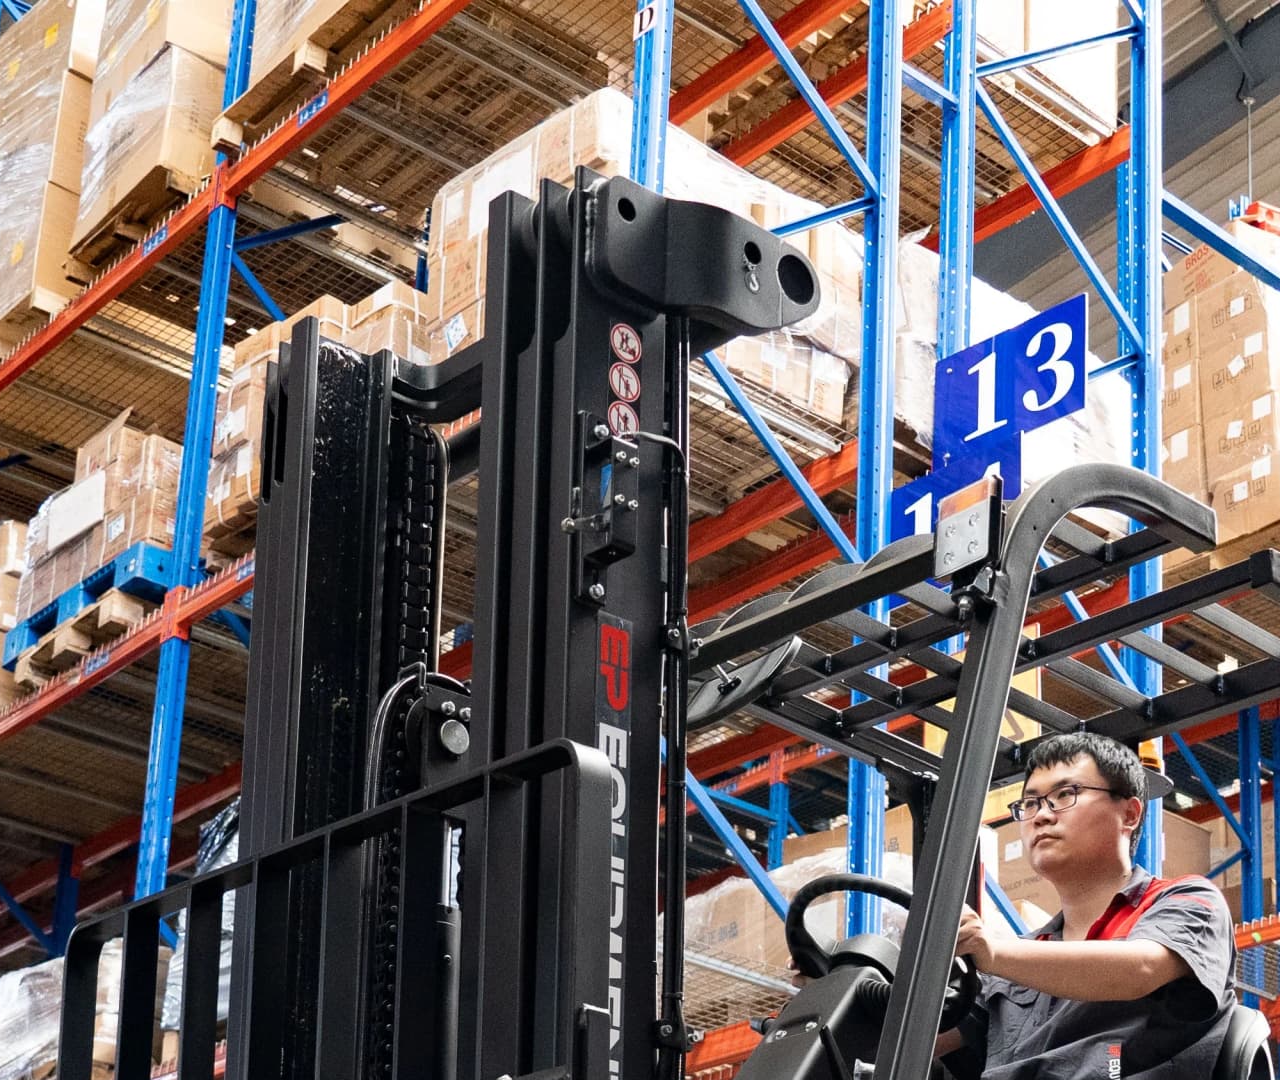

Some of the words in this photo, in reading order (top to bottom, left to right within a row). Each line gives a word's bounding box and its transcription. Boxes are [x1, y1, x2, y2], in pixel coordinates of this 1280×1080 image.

[638, 7, 654, 33] D
[964, 322, 1075, 442] 13
[600, 623, 629, 711] EP
